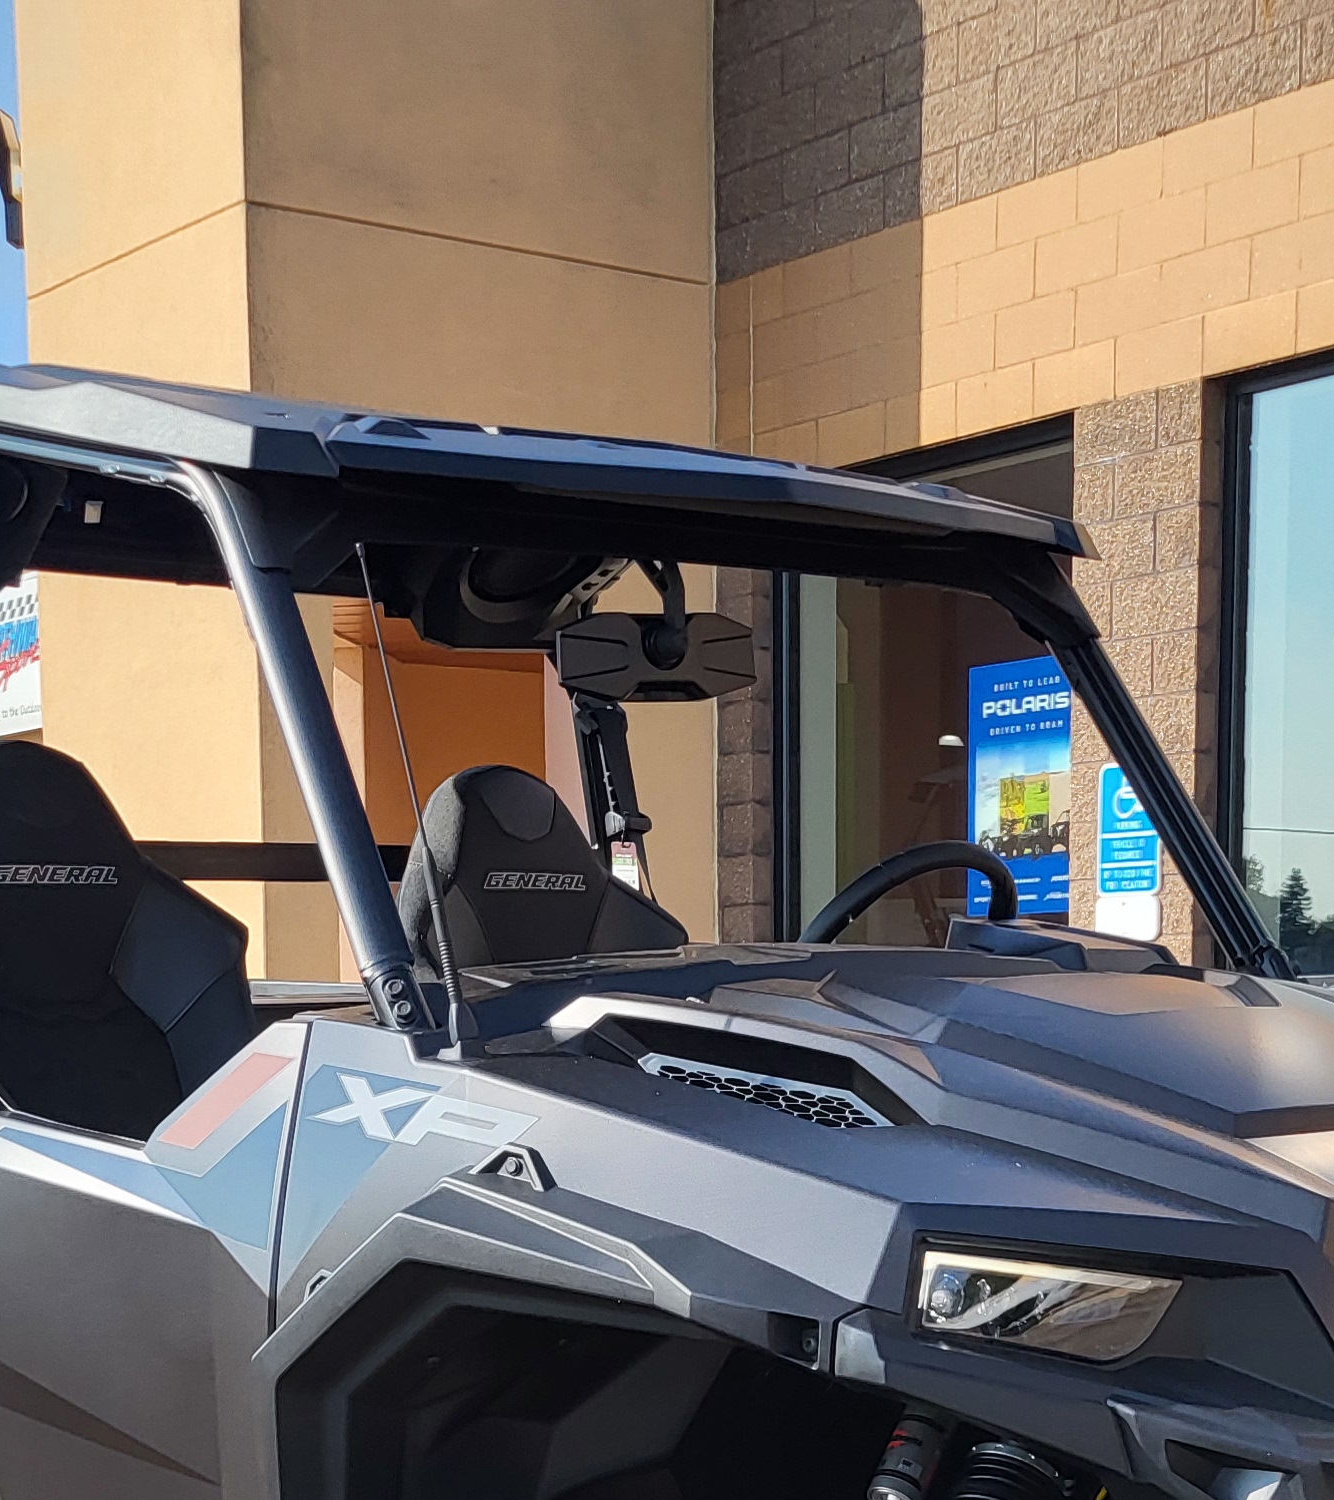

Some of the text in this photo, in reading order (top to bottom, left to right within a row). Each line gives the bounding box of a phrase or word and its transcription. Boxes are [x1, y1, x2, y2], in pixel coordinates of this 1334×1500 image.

[982, 692, 1069, 718] POLARIS
[483, 871, 588, 891] GENERAL
[312, 1072, 540, 1146] XP
